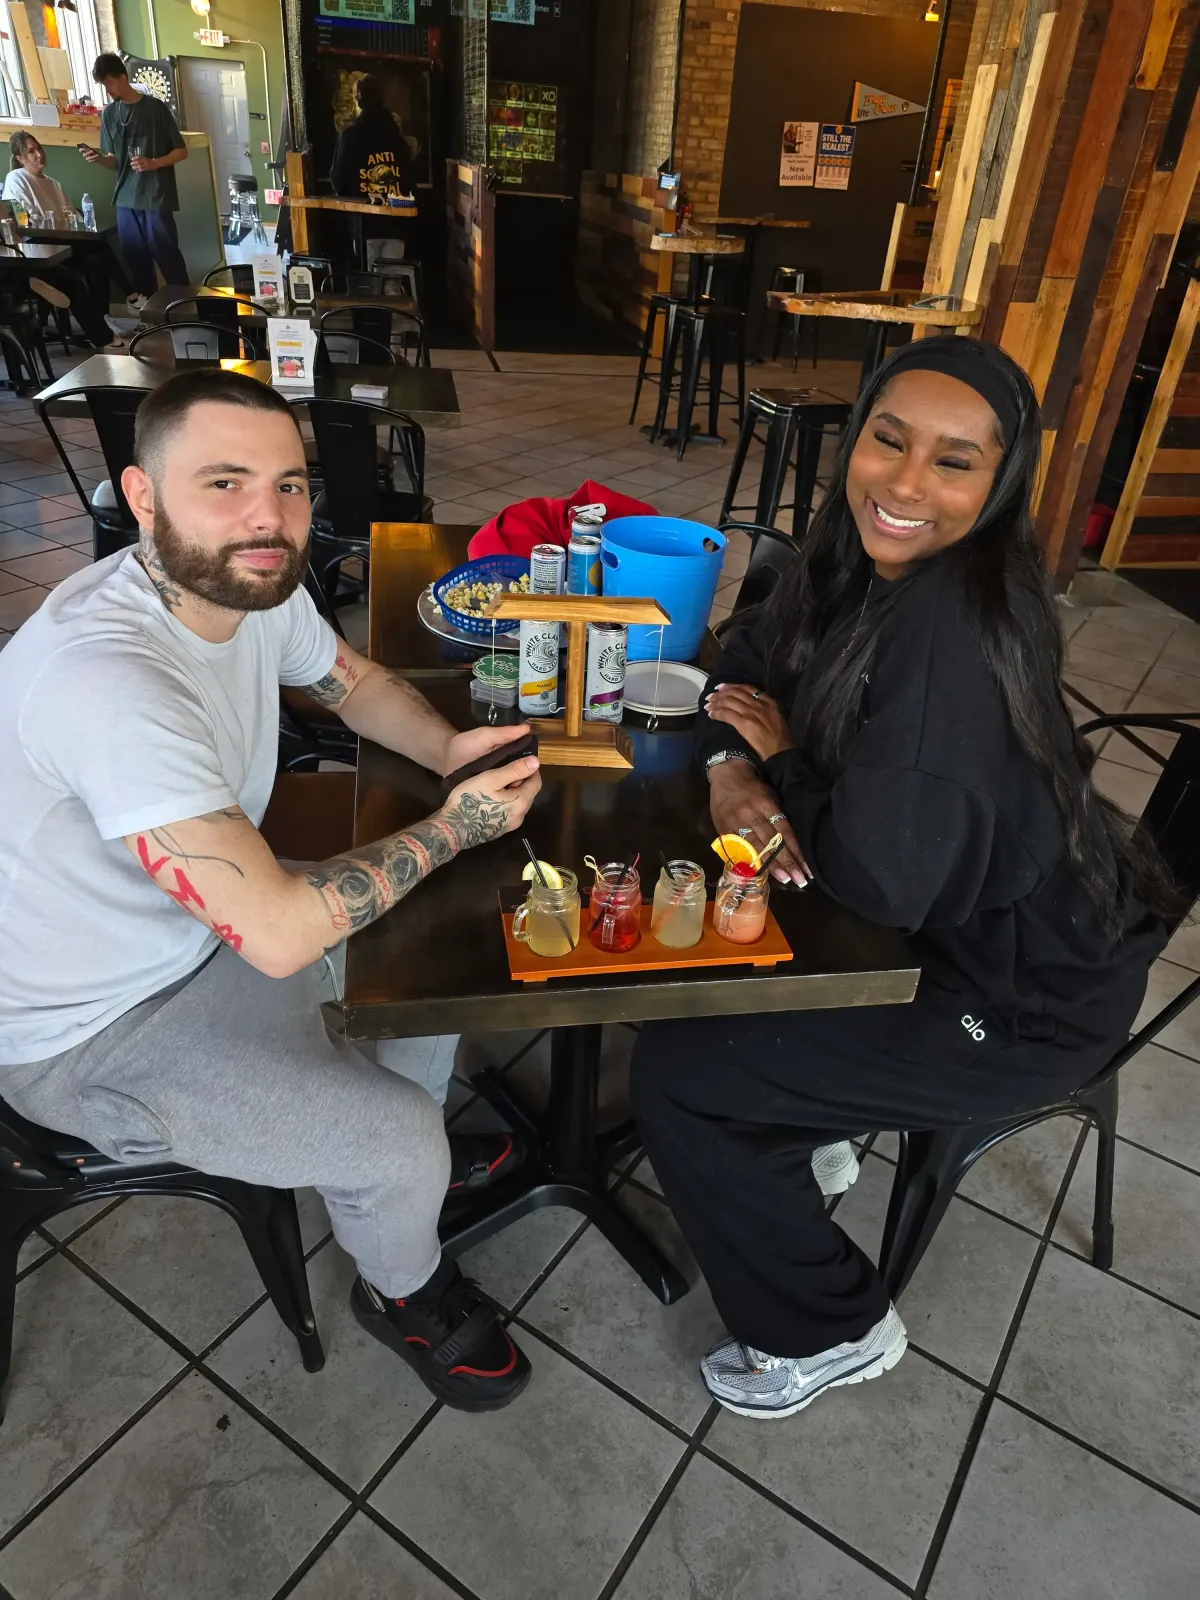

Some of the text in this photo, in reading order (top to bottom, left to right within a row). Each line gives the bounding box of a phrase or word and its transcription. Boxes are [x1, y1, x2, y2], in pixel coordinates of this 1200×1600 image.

[204, 31, 220, 44] EXIT
[542, 91, 556, 103] XO
[822, 133, 839, 143] STILL
[840, 135, 852, 144] THE
[822, 143, 850, 152] REALEST
[367, 151, 395, 165] ANTI
[525, 632, 558, 658] WHITE CLA
[598, 646, 614, 670] WHITE
[532, 662, 547, 672] HARD
[604, 673, 619, 682] HARD
[960, 1014, 986, 1041] alo
